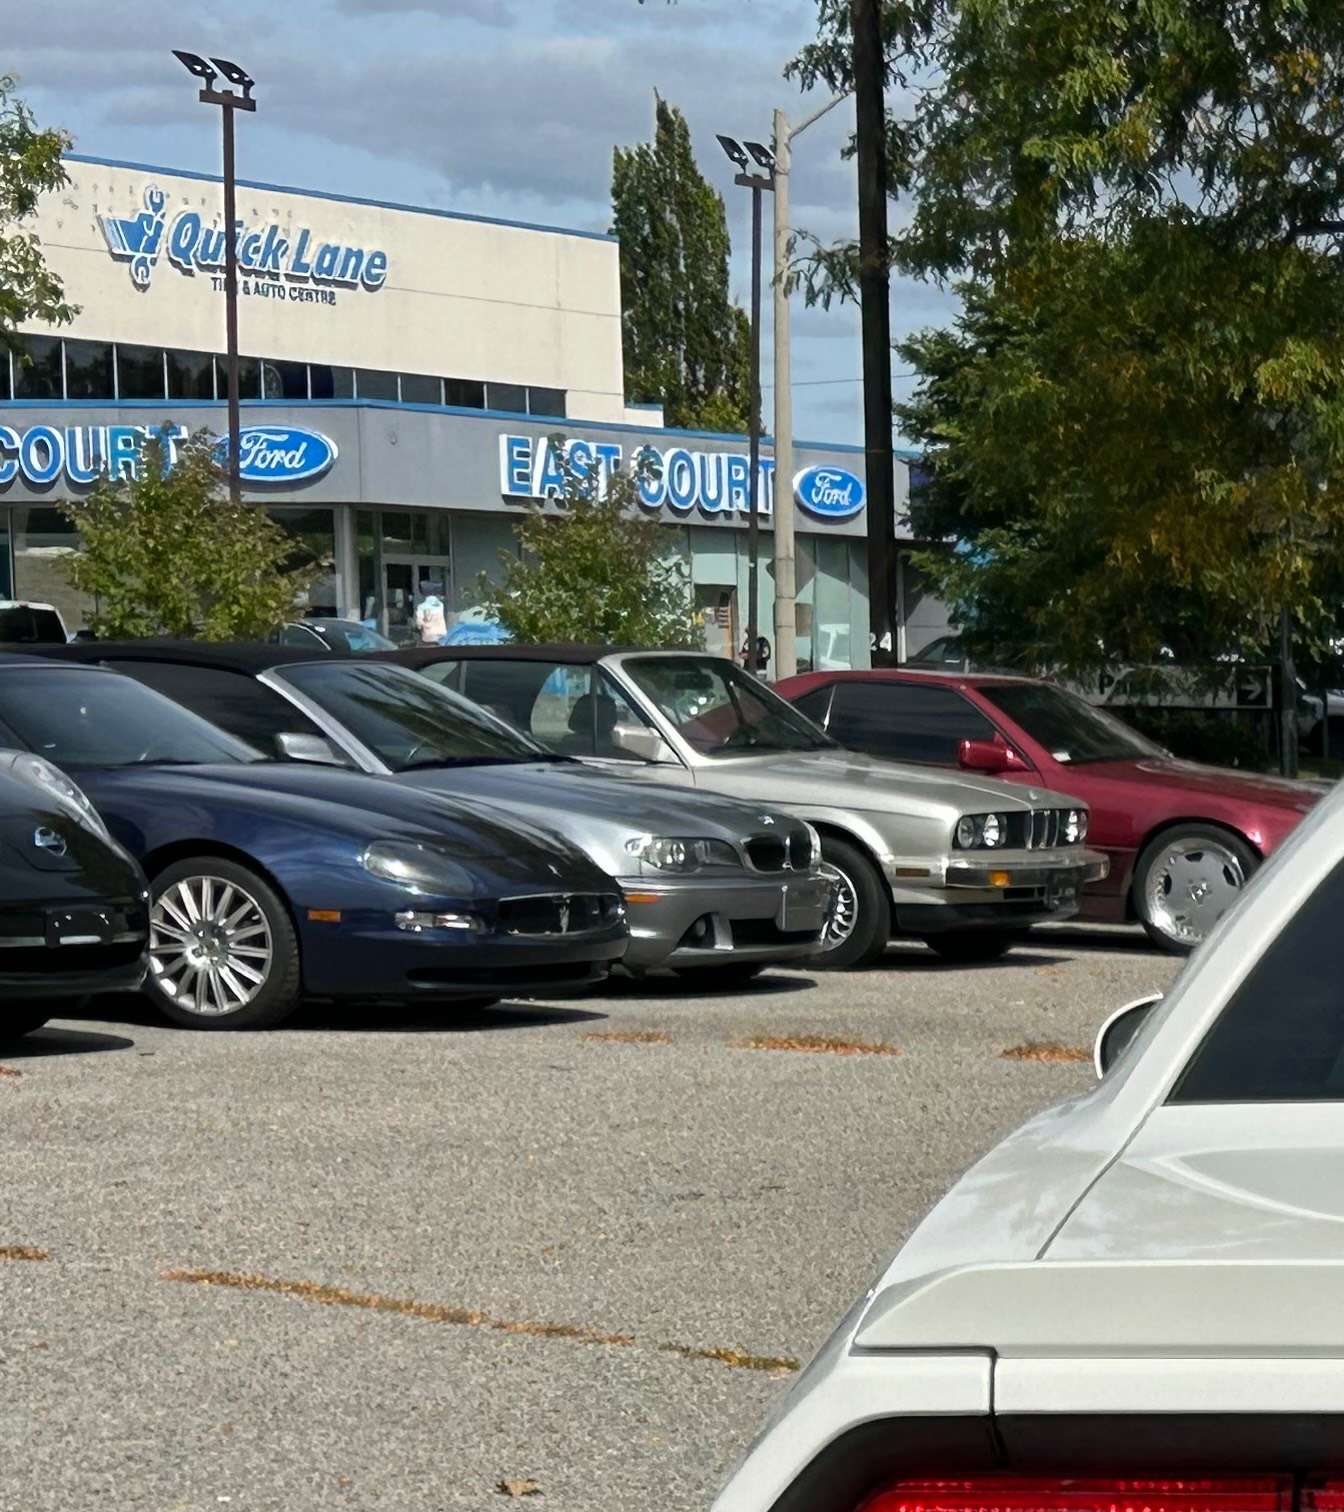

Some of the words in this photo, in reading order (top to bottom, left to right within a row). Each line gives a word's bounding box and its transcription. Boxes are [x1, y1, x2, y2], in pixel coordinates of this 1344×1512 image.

[290, 227, 389, 286] Lane
[242, 280, 251, 296] &
[254, 281, 286, 299] AUTO
[289, 286, 337, 305] CENTRE
[237, 431, 306, 470] Ford
[499, 434, 622, 501] EAST
[811, 472, 855, 507] Ford
